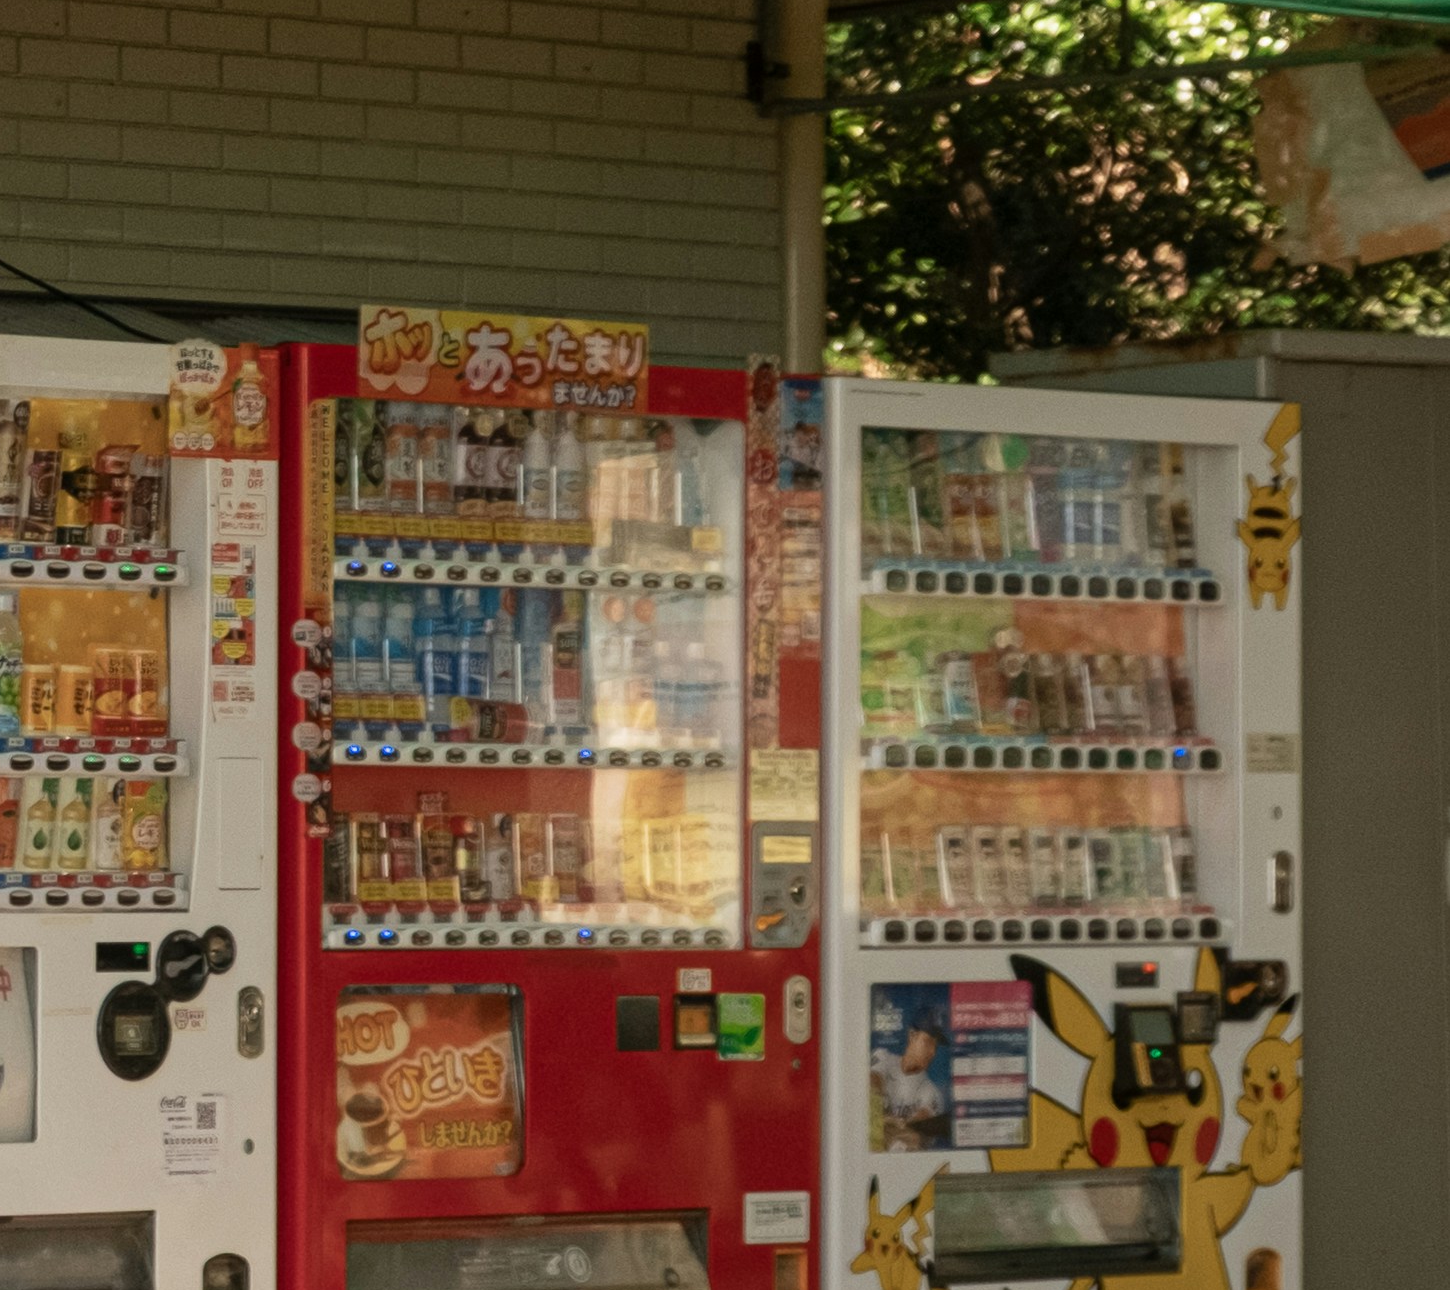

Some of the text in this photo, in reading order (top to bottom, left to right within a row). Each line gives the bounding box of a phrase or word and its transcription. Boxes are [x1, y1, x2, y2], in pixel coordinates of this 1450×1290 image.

[365, 308, 646, 393] ホッとあったまり
[553, 383, 637, 406] ませんか?
[336, 1011, 397, 1057] HOT
[388, 1045, 506, 1114] ひといき
[420, 1120, 514, 1150] しませんか?
